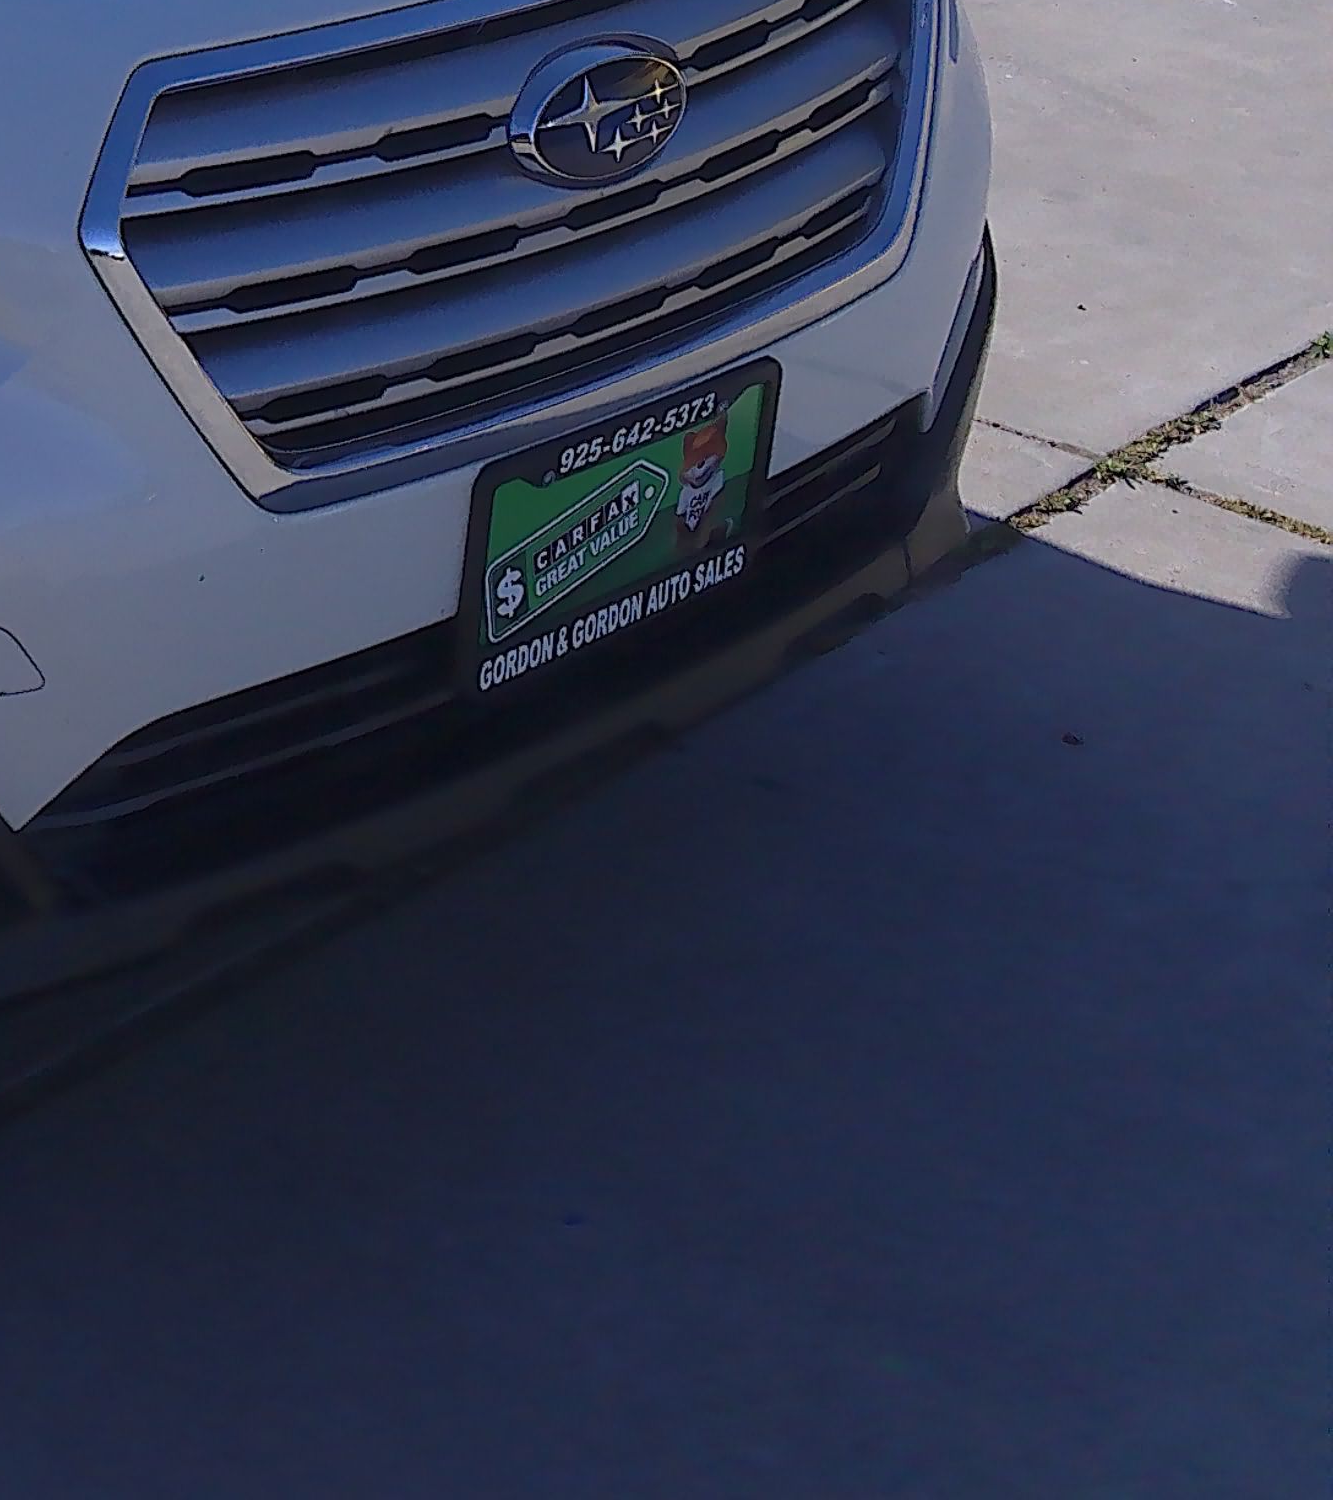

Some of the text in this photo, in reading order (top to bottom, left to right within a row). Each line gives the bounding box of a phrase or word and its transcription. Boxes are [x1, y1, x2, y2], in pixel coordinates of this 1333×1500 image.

[559, 392, 717, 475] 925-642-5373
[533, 480, 641, 573] CARFAX
[535, 508, 640, 597] GREAT VALUE
[479, 545, 746, 692] GORDON & GORDON AUTO SALES
[495, 566, 525, 619] $
